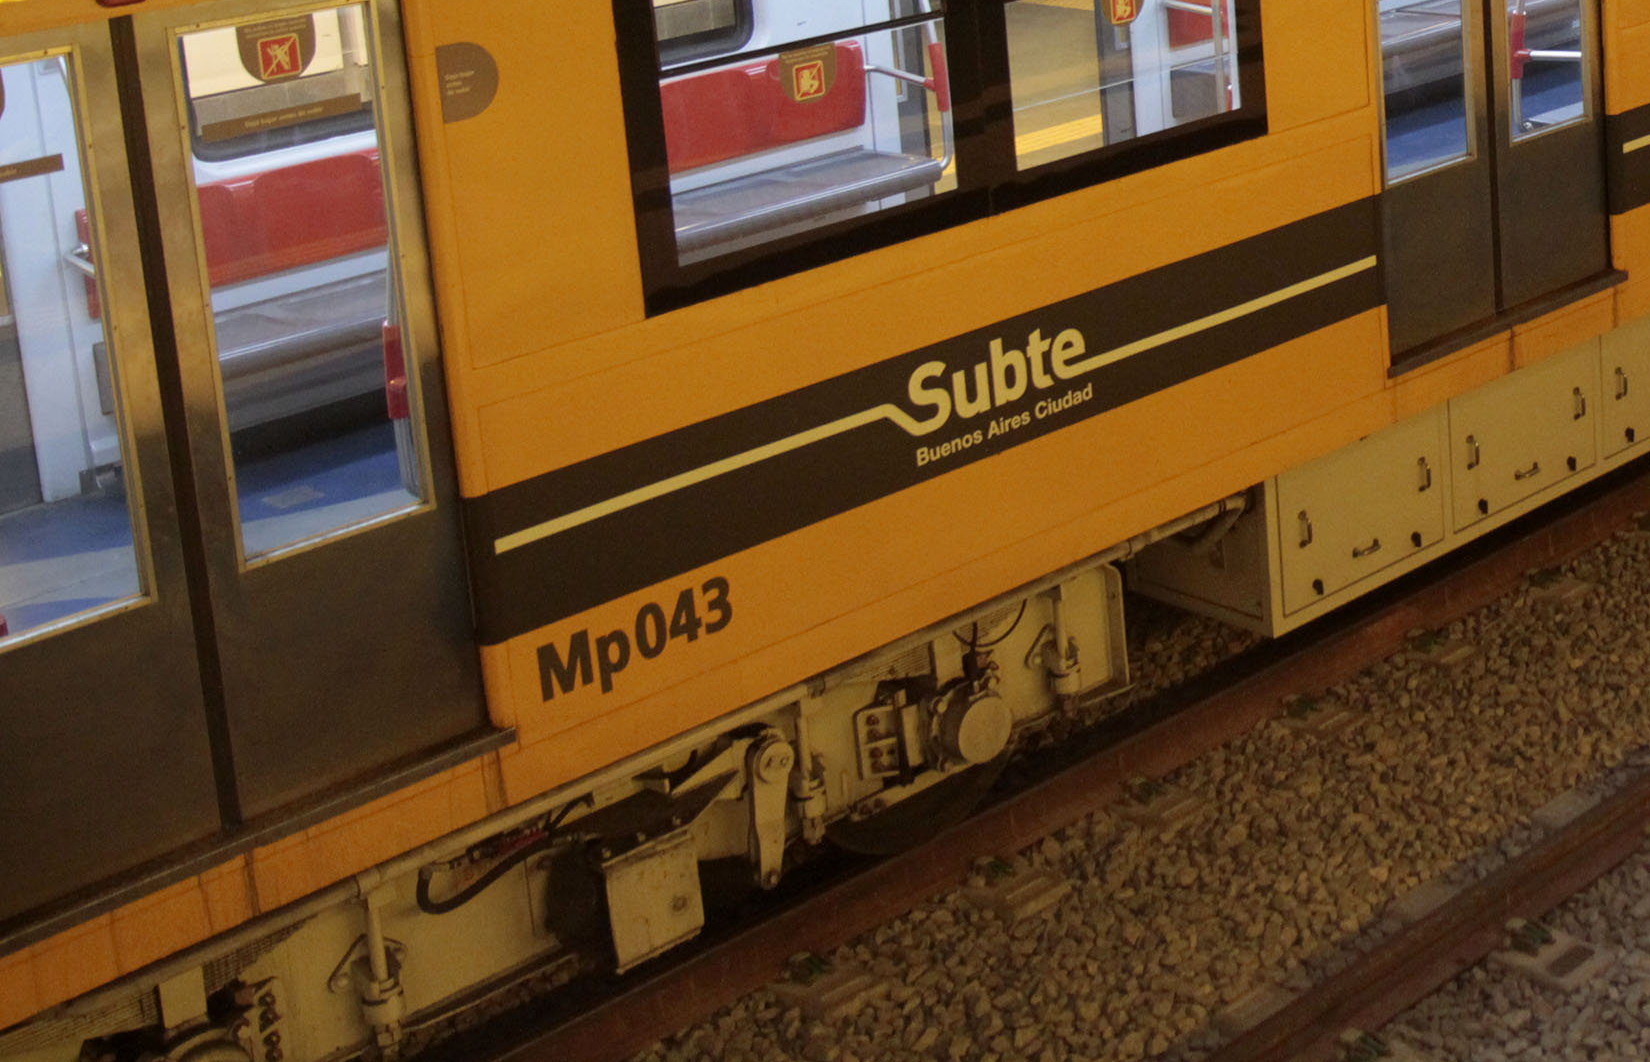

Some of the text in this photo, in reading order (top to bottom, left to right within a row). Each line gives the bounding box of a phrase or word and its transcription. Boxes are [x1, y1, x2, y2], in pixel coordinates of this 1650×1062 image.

[907, 327, 1088, 437] Subte
[915, 382, 1094, 467] Buenos Aires Ciudad
[537, 576, 733, 703] Mp043
